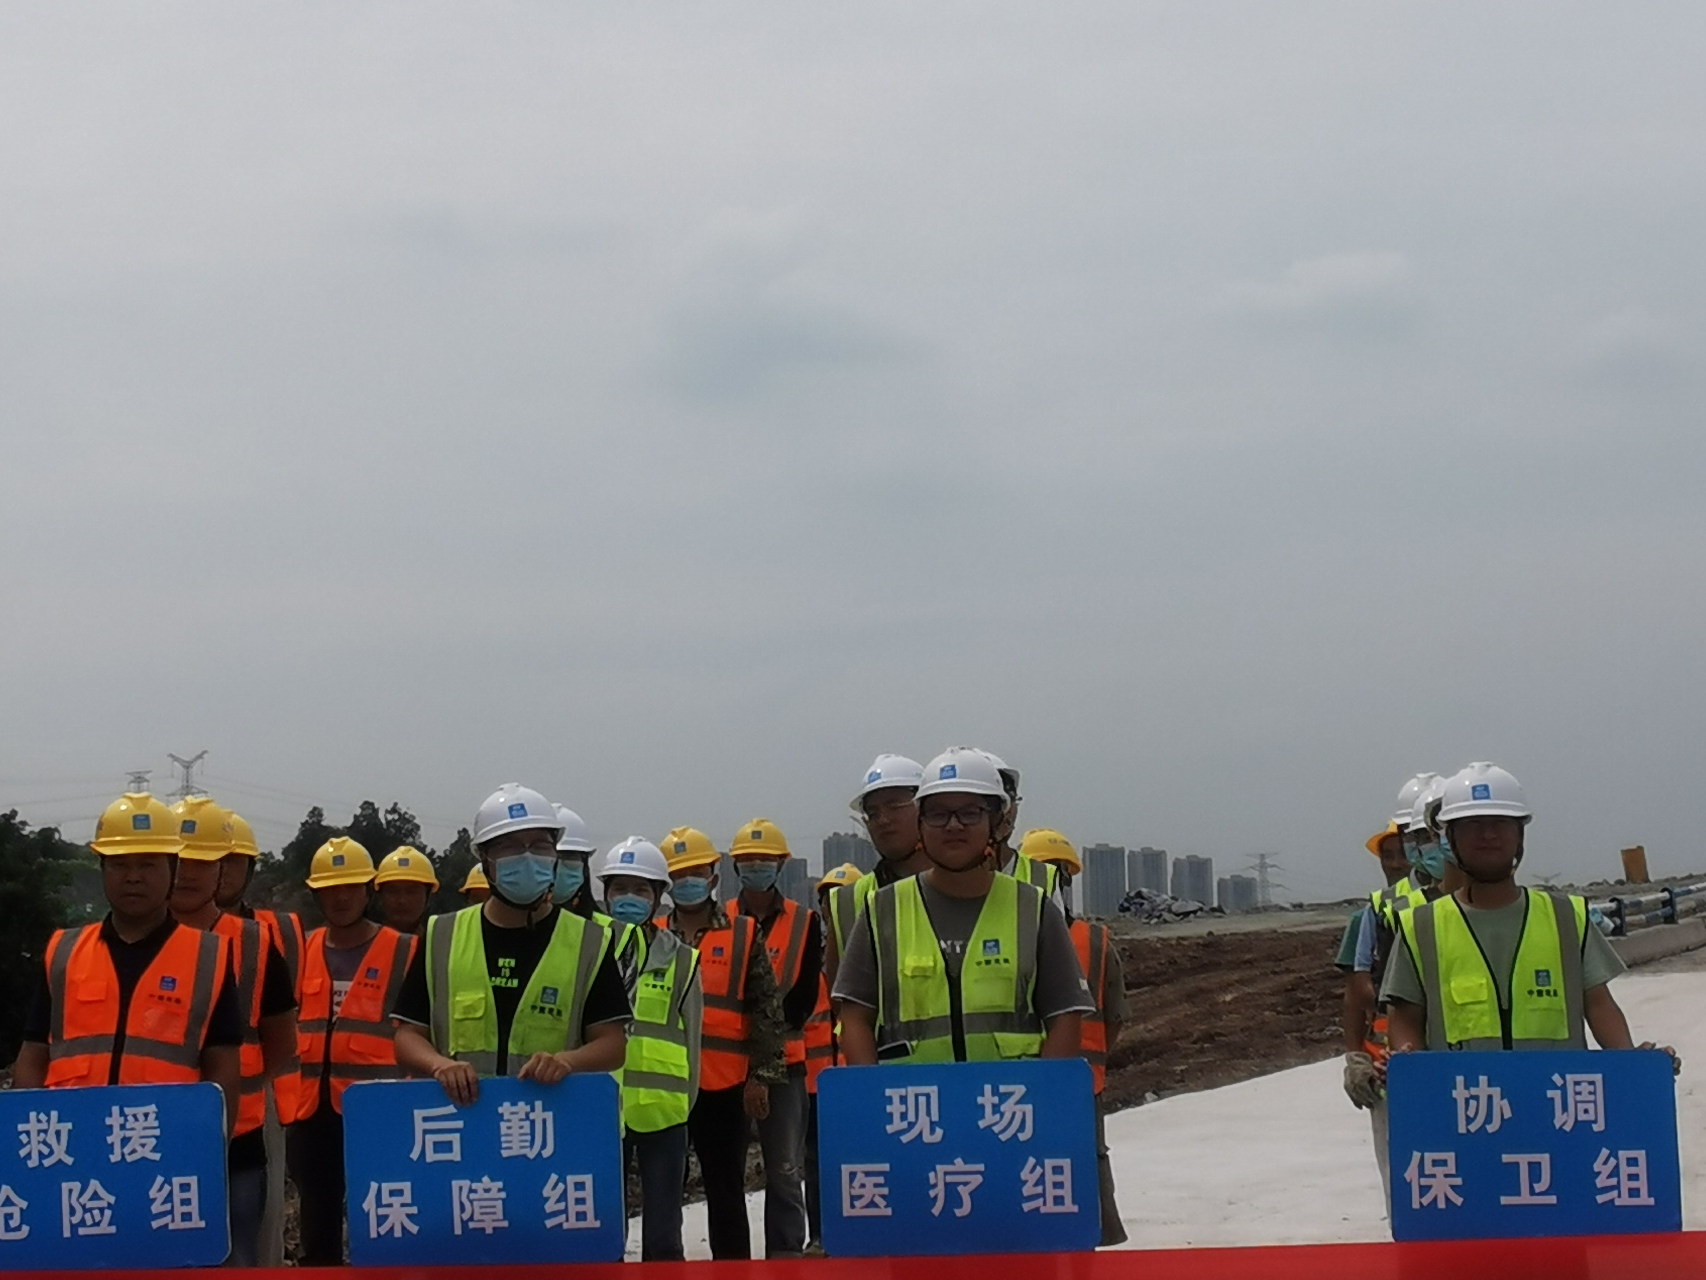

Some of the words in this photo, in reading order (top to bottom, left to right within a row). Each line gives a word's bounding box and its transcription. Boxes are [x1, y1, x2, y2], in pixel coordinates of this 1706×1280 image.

[409, 1099, 555, 1163] 后勤
[885, 1083, 1035, 1143] 现场
[1451, 1072, 1607, 1134] 协调
[16, 1103, 162, 1169] 救援
[362, 1173, 601, 1239] 保障组
[841, 1156, 1079, 1218] 医疗组
[1404, 1147, 1656, 1210] 保卫组
